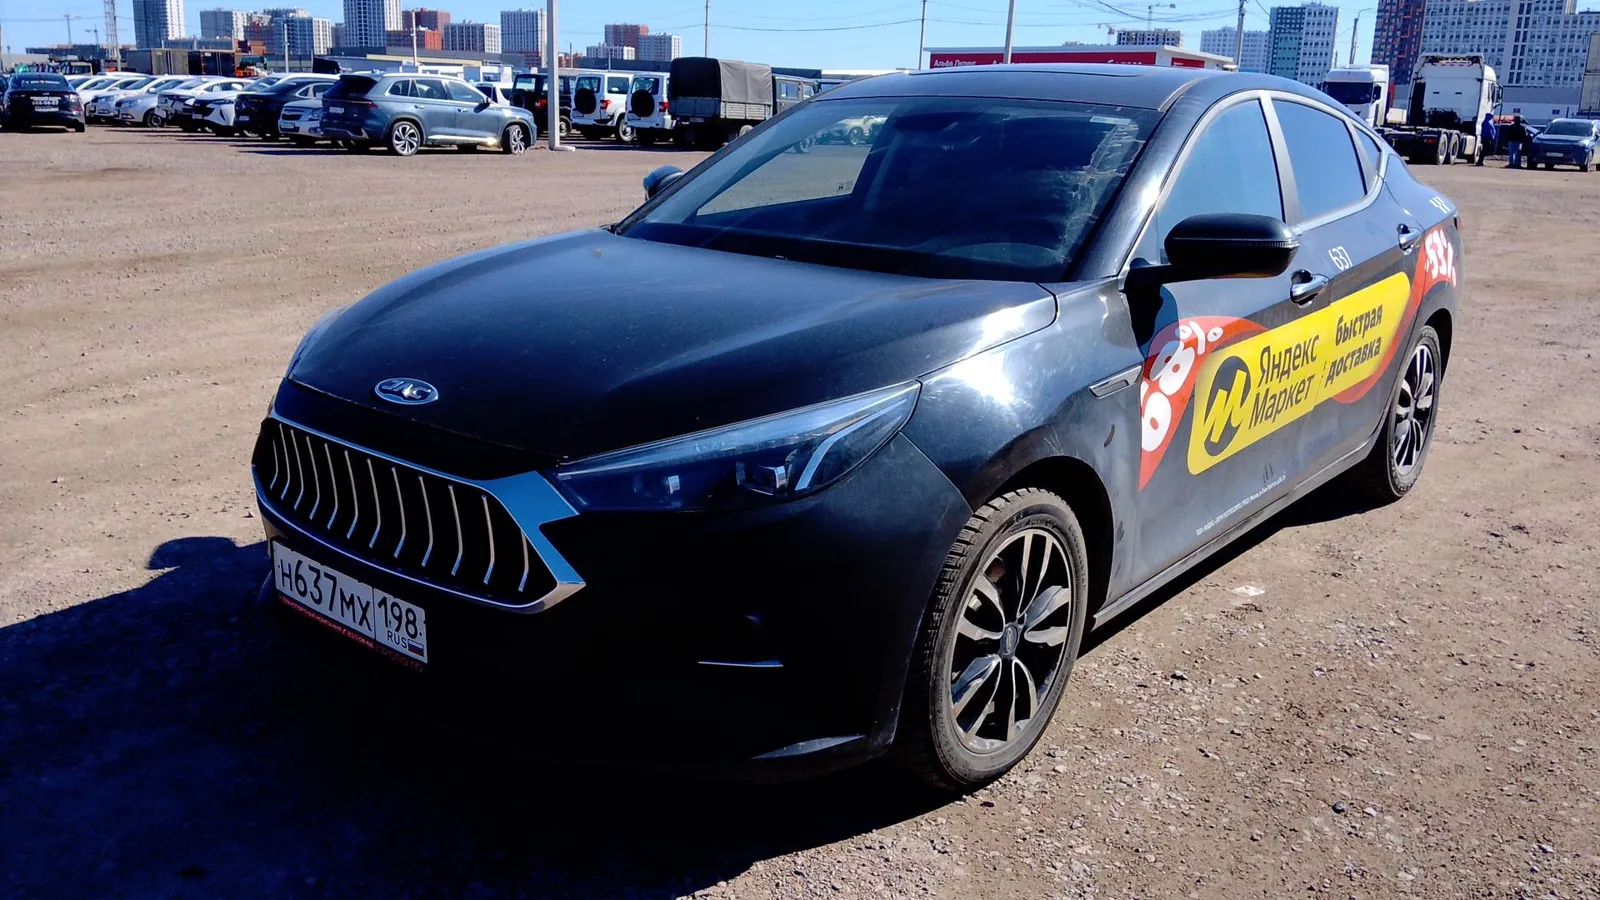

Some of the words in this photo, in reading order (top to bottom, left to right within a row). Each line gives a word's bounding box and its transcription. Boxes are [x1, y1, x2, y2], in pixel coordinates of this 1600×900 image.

[1328, 246, 1353, 271] 637
[1335, 303, 1384, 347] быстрая
[1259, 334, 1320, 387] Яндекс
[1325, 336, 1383, 386] доставка
[1248, 374, 1316, 430] Маркет
[377, 596, 418, 640] 198
[386, 630, 409, 650] RUS
